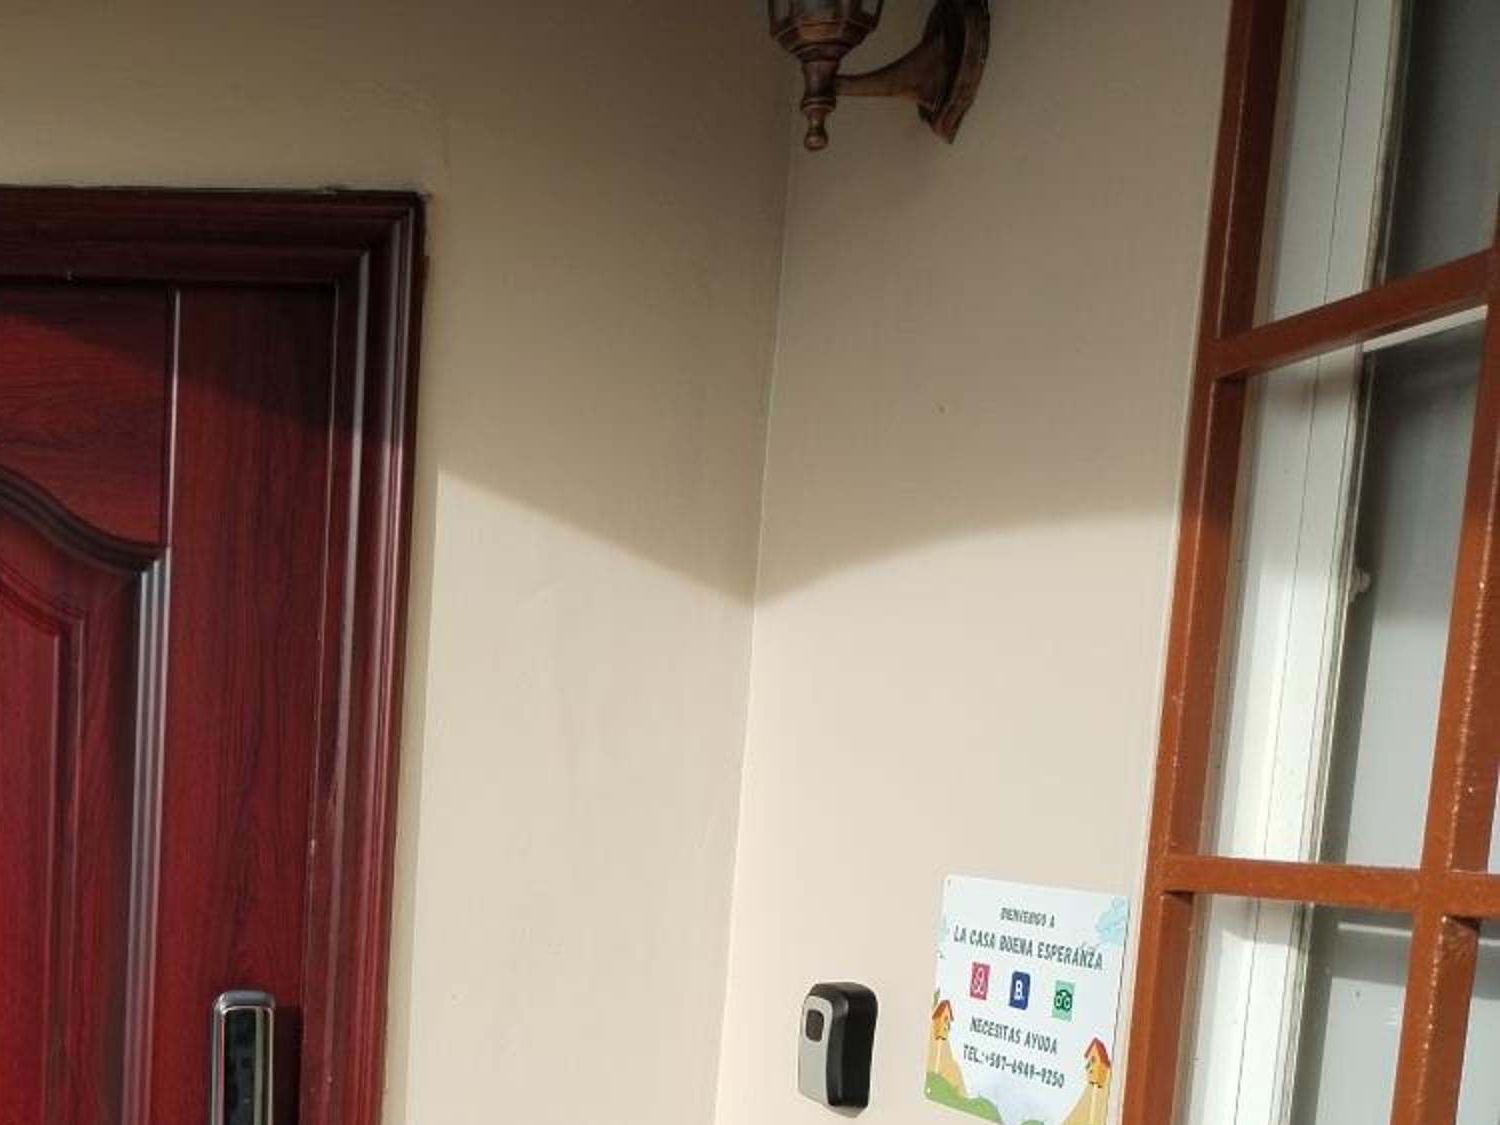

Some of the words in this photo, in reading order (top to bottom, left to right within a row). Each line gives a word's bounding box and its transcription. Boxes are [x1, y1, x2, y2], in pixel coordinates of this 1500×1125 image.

[953, 924, 967, 943] LA
[969, 929, 995, 949] CASA
[1000, 935, 1033, 957] BUENA
[1037, 941, 1103, 971] ESPERANZA
[970, 1015, 1020, 1044] NECESITAS
[1024, 1031, 1057, 1055] AYUDA
